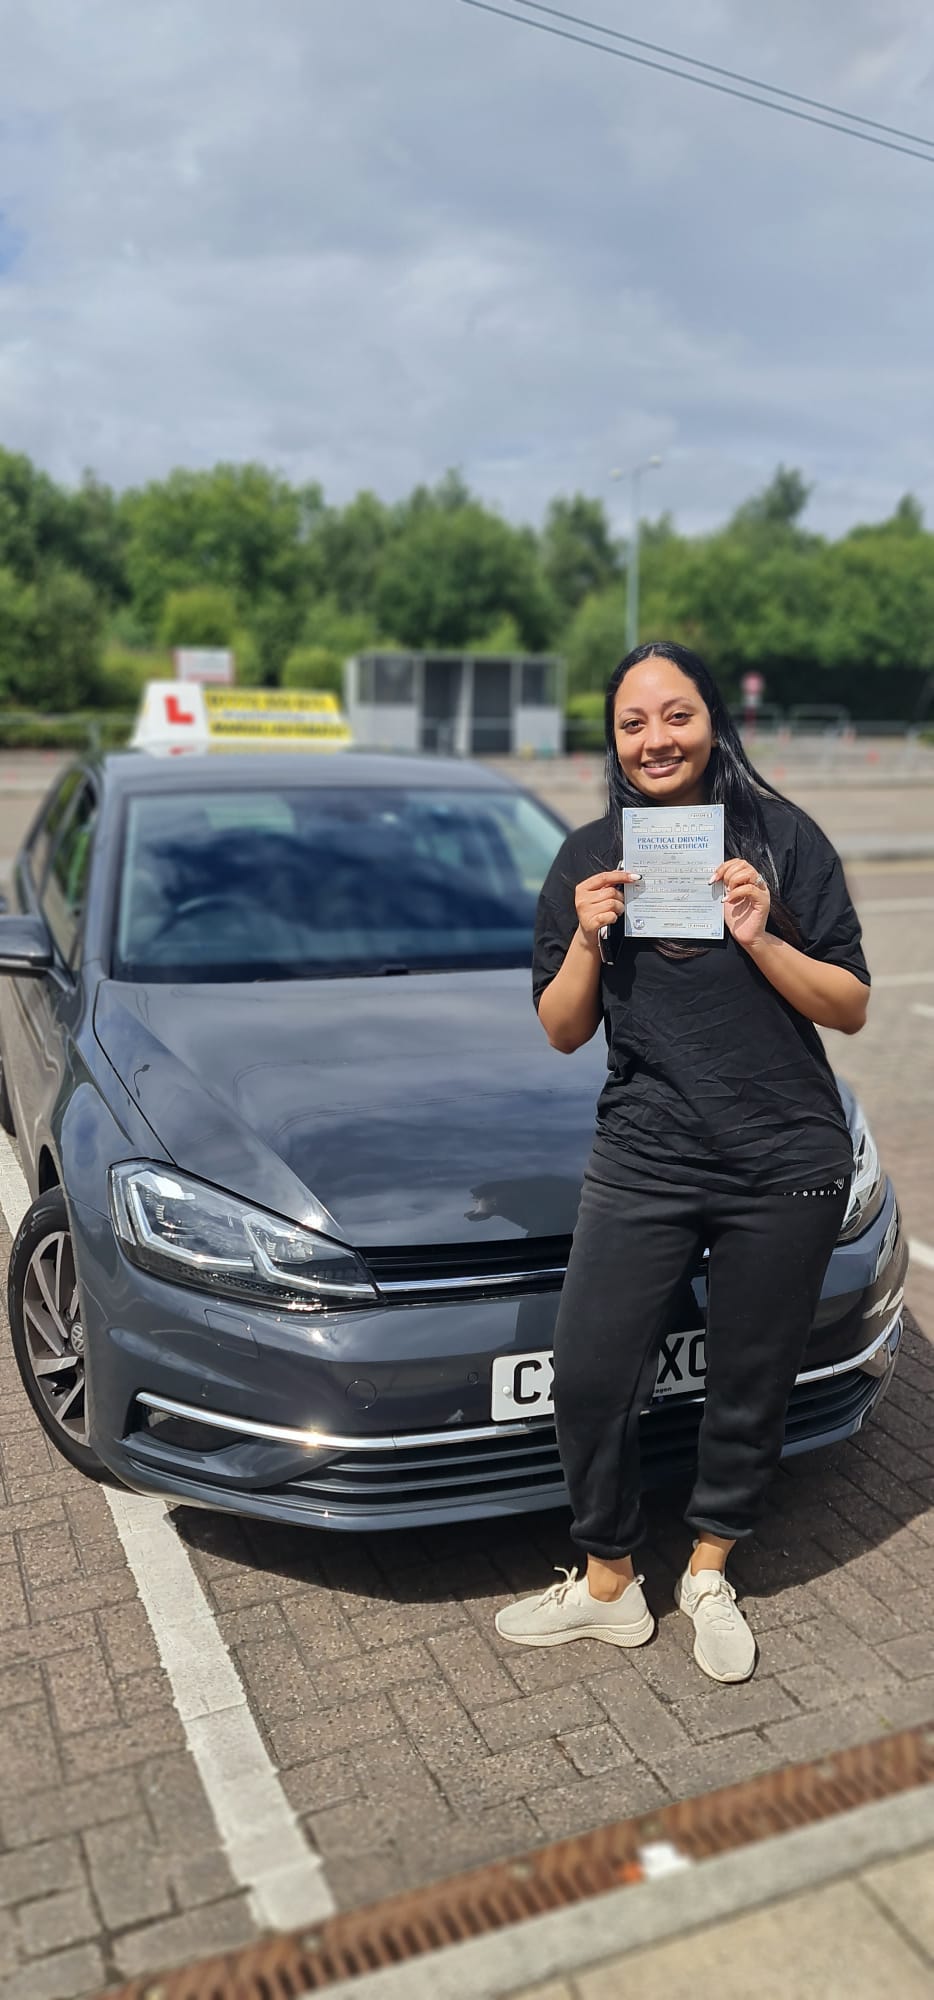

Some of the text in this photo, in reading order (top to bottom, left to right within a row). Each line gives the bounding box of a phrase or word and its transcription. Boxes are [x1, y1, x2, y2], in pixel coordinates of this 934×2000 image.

[165, 695, 195, 725] L
[637, 835, 709, 844] PRACTICAL DRIVING
[670, 842, 708, 850] CERTIFICATE
